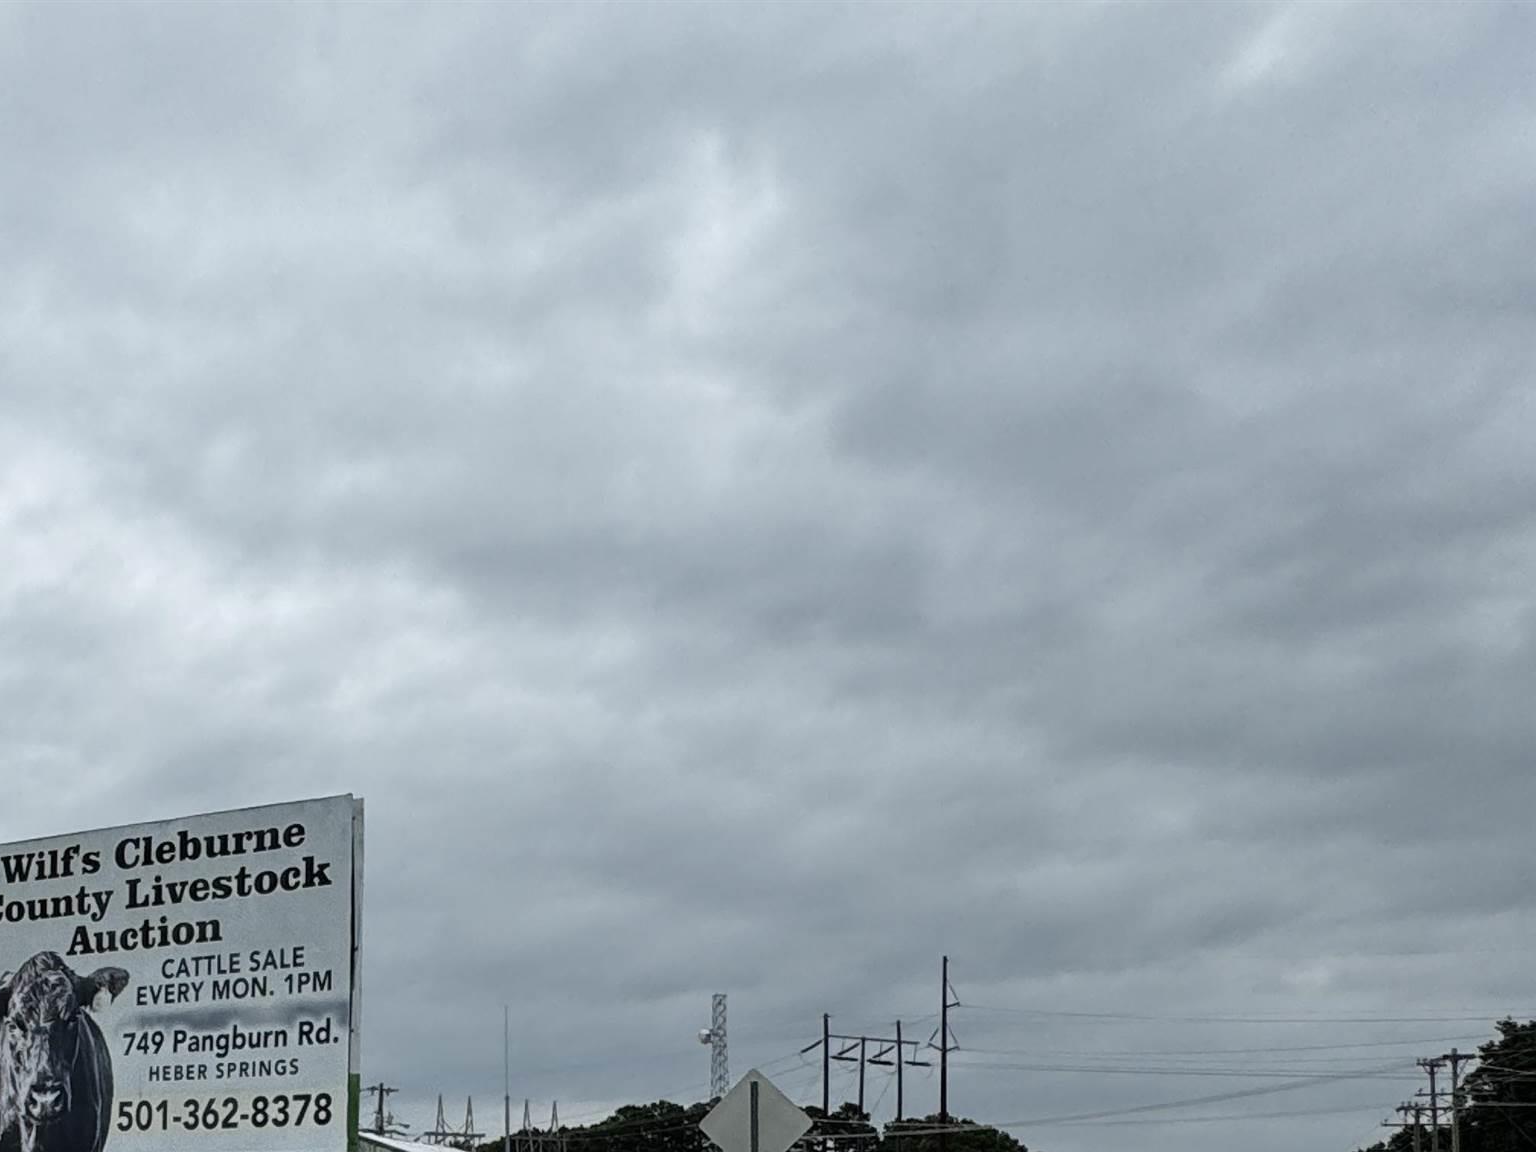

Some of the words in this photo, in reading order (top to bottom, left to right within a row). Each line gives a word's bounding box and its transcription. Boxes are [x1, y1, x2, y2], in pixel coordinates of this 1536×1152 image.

[0, 844, 102, 884] Wilf's
[114, 823, 306, 870] Cleburne
[124, 855, 333, 910] Livestock
[65, 916, 223, 957] Auction
[161, 953, 241, 980] CATTLE
[248, 946, 305, 973] SALE
[136, 981, 205, 1006] EVERY
[211, 975, 275, 1001] MON.
[283, 969, 333, 995] 1PM
[122, 1030, 165, 1056] 749
[172, 1024, 288, 1059] Pangburn
[297, 1016, 340, 1046] Rd.
[148, 1063, 208, 1082] HEBER
[215, 1058, 299, 1079] SPRINGS
[116, 1092, 333, 1132] 501-362-8378
